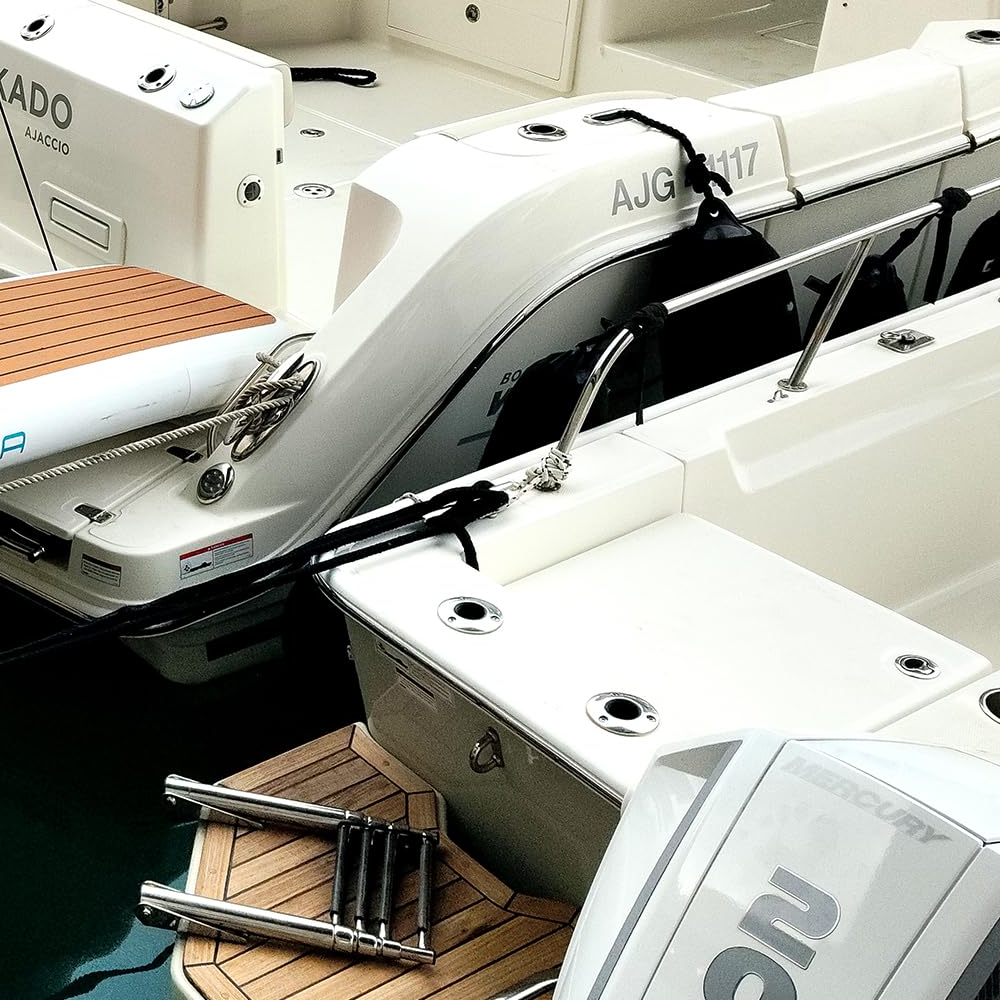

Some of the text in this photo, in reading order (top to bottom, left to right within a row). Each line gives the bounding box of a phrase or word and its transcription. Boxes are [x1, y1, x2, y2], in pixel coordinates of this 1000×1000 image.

[24, 126, 70, 156] AJACCIO
[611, 166, 676, 216] AJG
[780, 756, 953, 844] MERCURY
